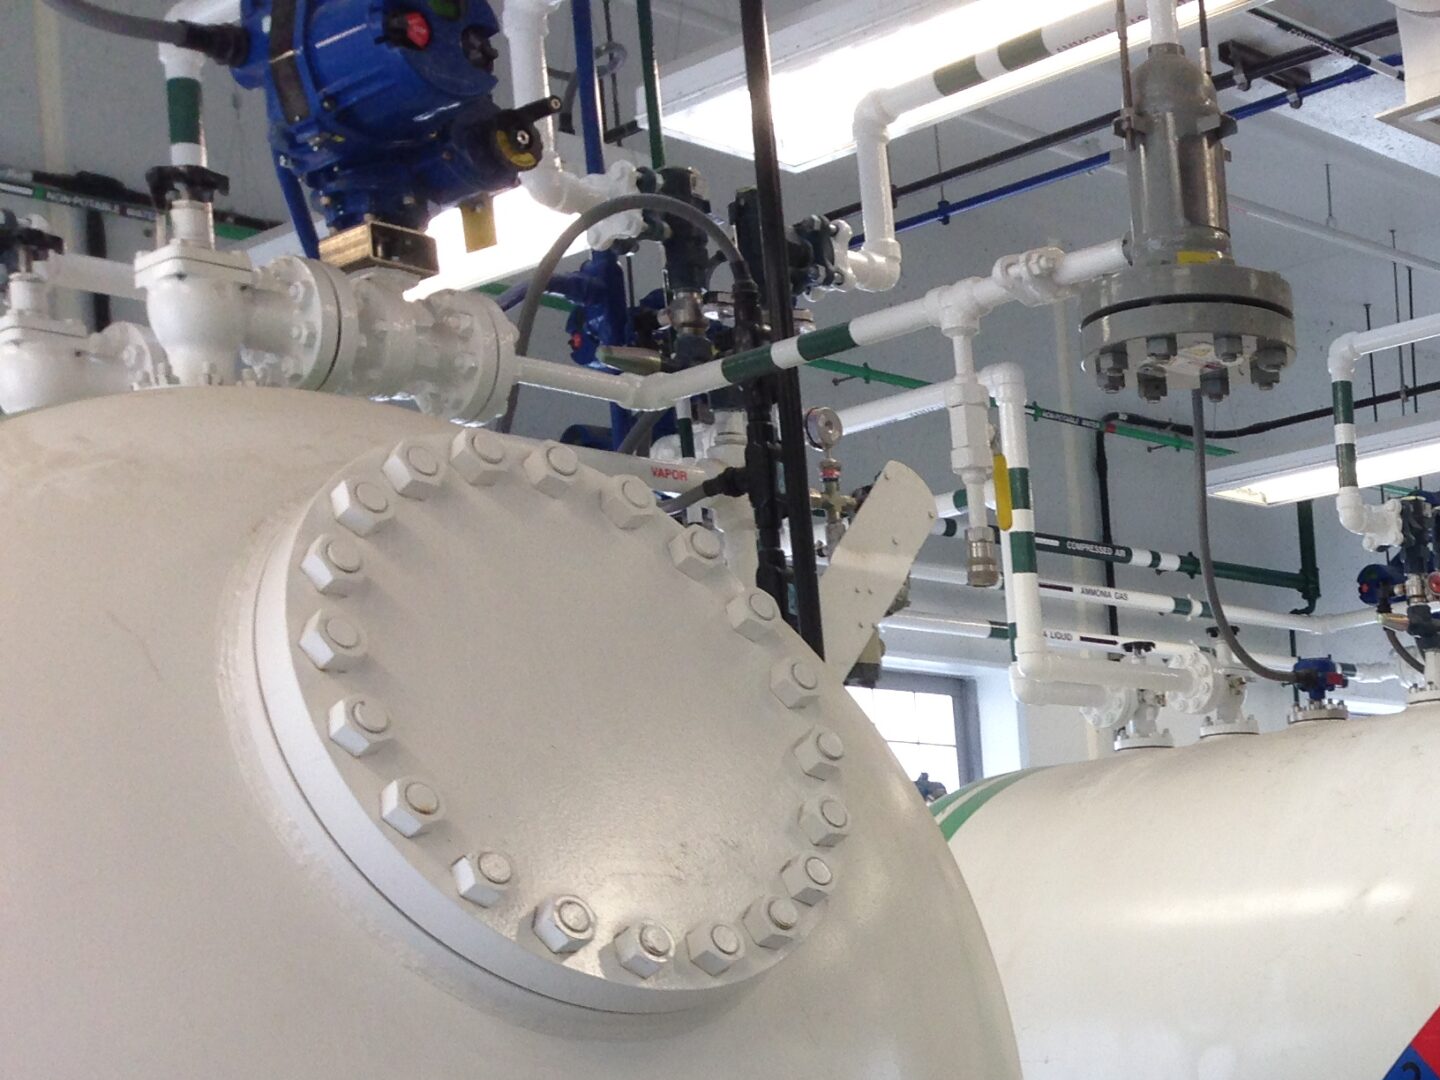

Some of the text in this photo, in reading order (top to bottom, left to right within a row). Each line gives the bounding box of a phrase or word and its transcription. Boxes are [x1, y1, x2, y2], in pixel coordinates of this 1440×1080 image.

[651, 466, 688, 481] VAPOR
[1066, 540, 1127, 558] COMPRESSED AIR
[1080, 587, 1129, 601] AMMONIA GAS
